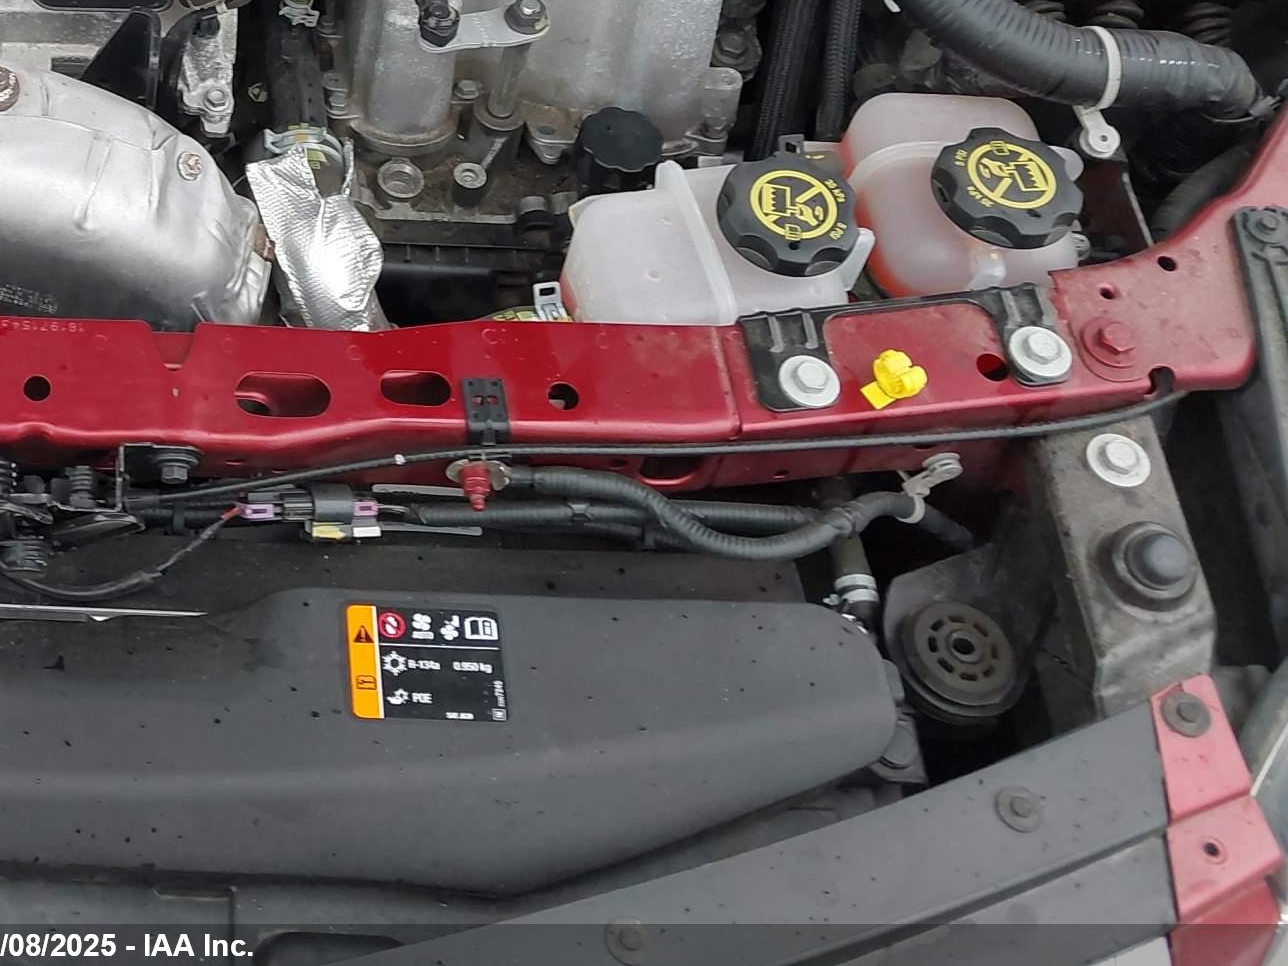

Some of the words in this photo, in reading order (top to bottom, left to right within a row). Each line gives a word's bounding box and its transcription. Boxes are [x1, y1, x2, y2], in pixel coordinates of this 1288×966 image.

[407, 659, 441, 671] R-134a
[479, 662, 493, 674] kg
[412, 692, 433, 704] POE
